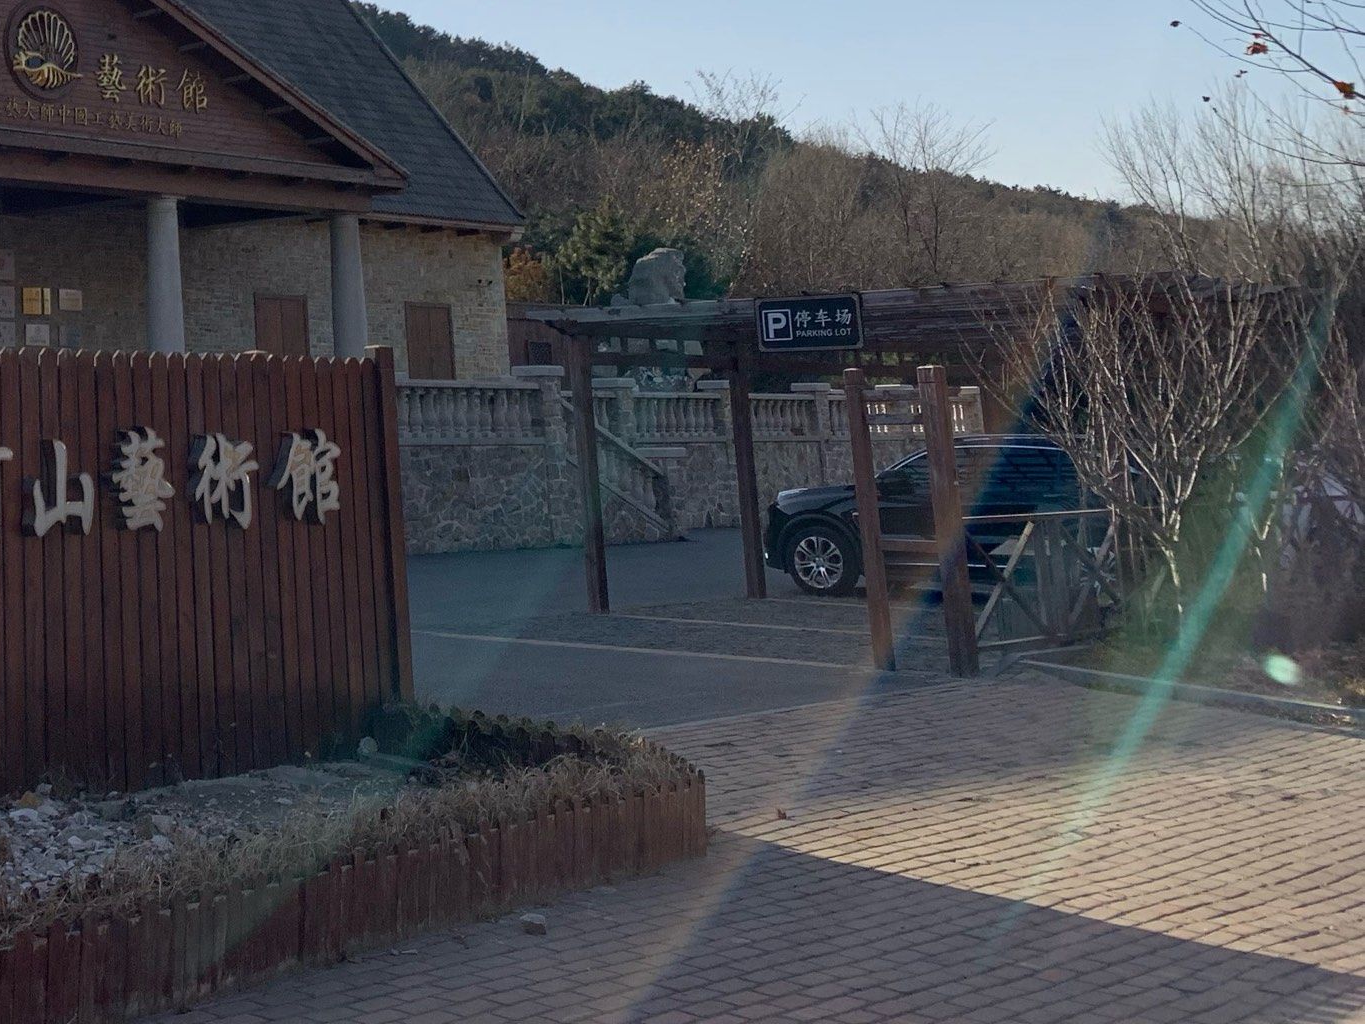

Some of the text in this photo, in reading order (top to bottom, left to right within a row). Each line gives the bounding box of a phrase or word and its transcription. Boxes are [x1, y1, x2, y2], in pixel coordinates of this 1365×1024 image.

[96, 54, 209, 114] 藝術館
[767, 313, 787, 338] P
[794, 308, 853, 328] 停车场
[796, 328, 852, 338] PARKING LOT
